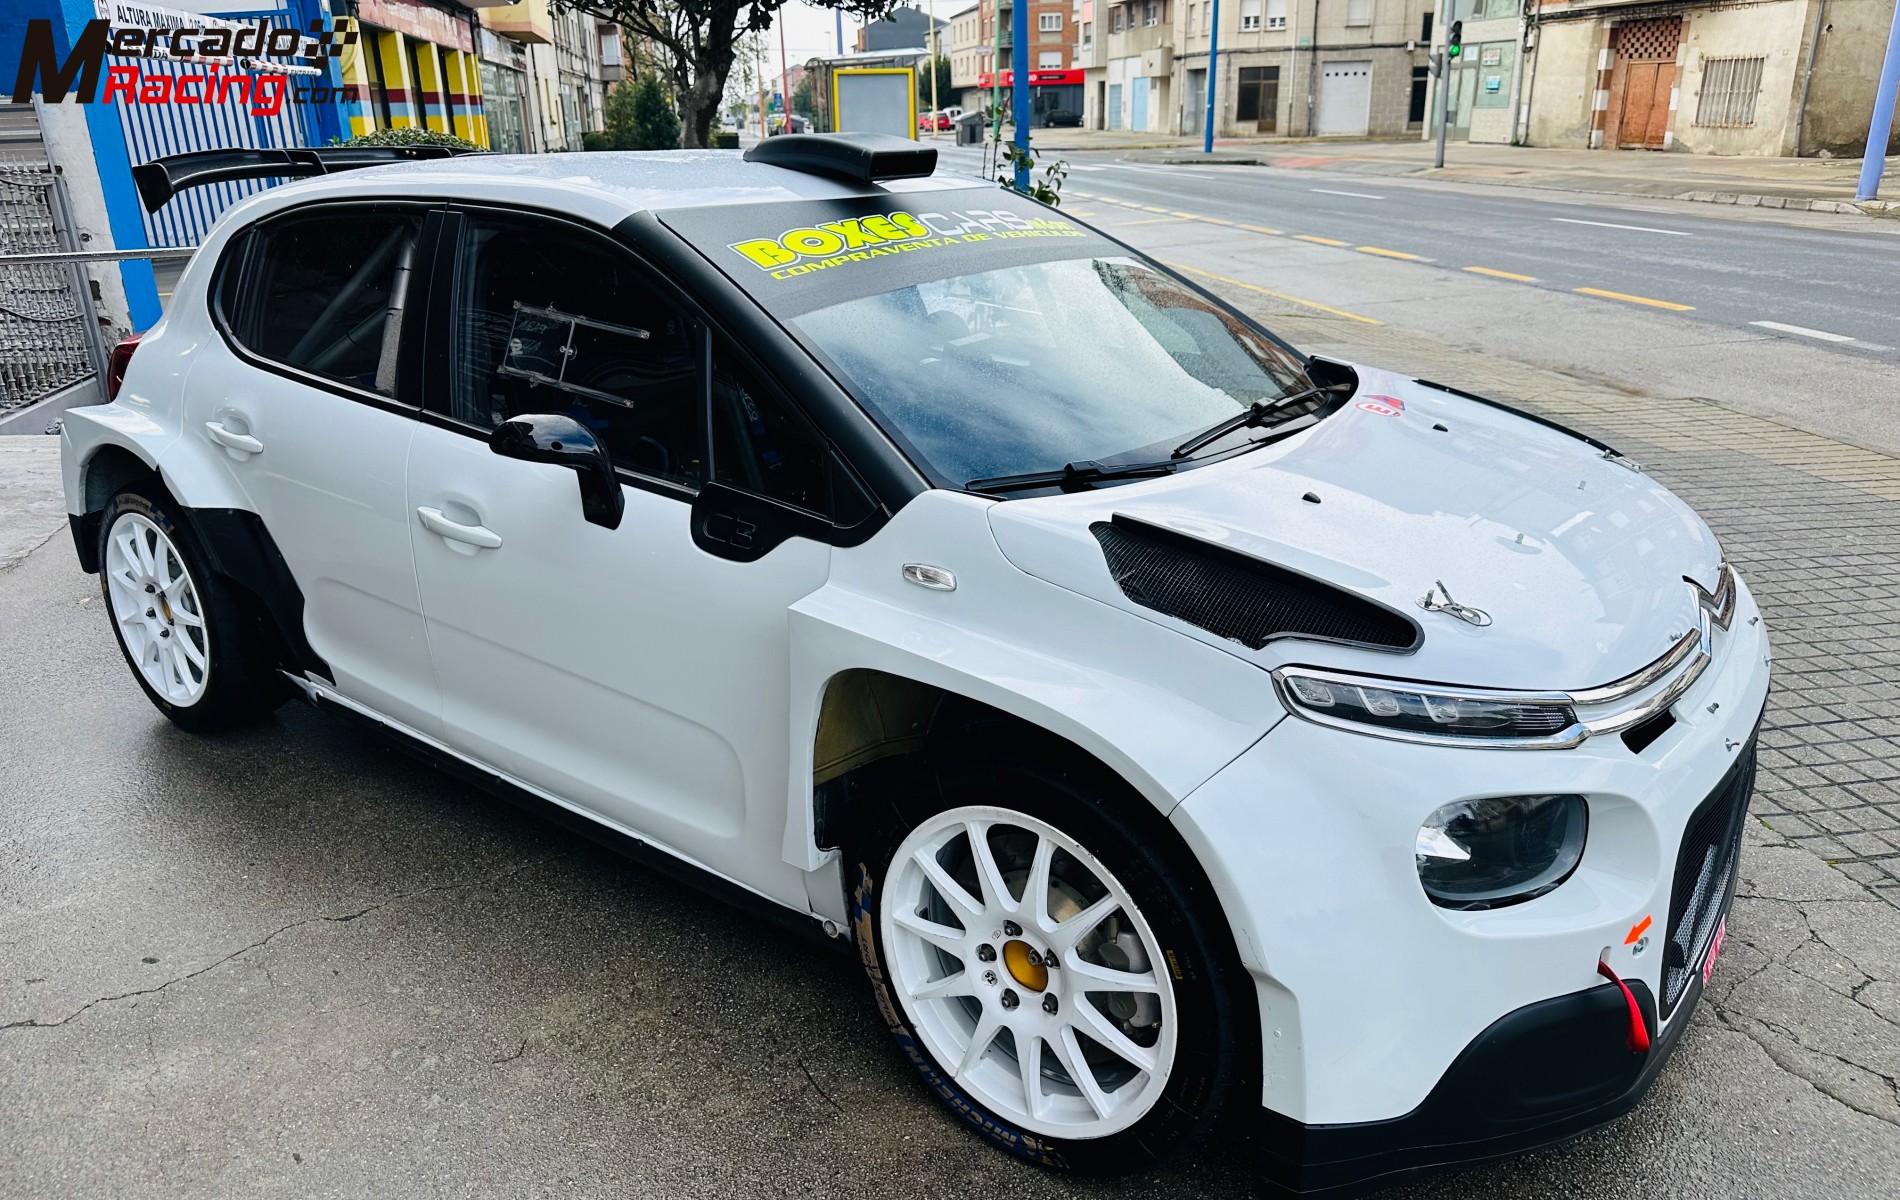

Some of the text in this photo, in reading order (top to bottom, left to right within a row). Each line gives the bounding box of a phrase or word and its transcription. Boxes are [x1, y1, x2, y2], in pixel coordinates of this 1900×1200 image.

[117, 5, 153, 28] ALTURA
[770, 237, 961, 280] COMPRAVENTA
[960, 232, 993, 243] DE
[702, 511, 756, 550] C3
[903, 1044, 1018, 1148] MICHELIN
